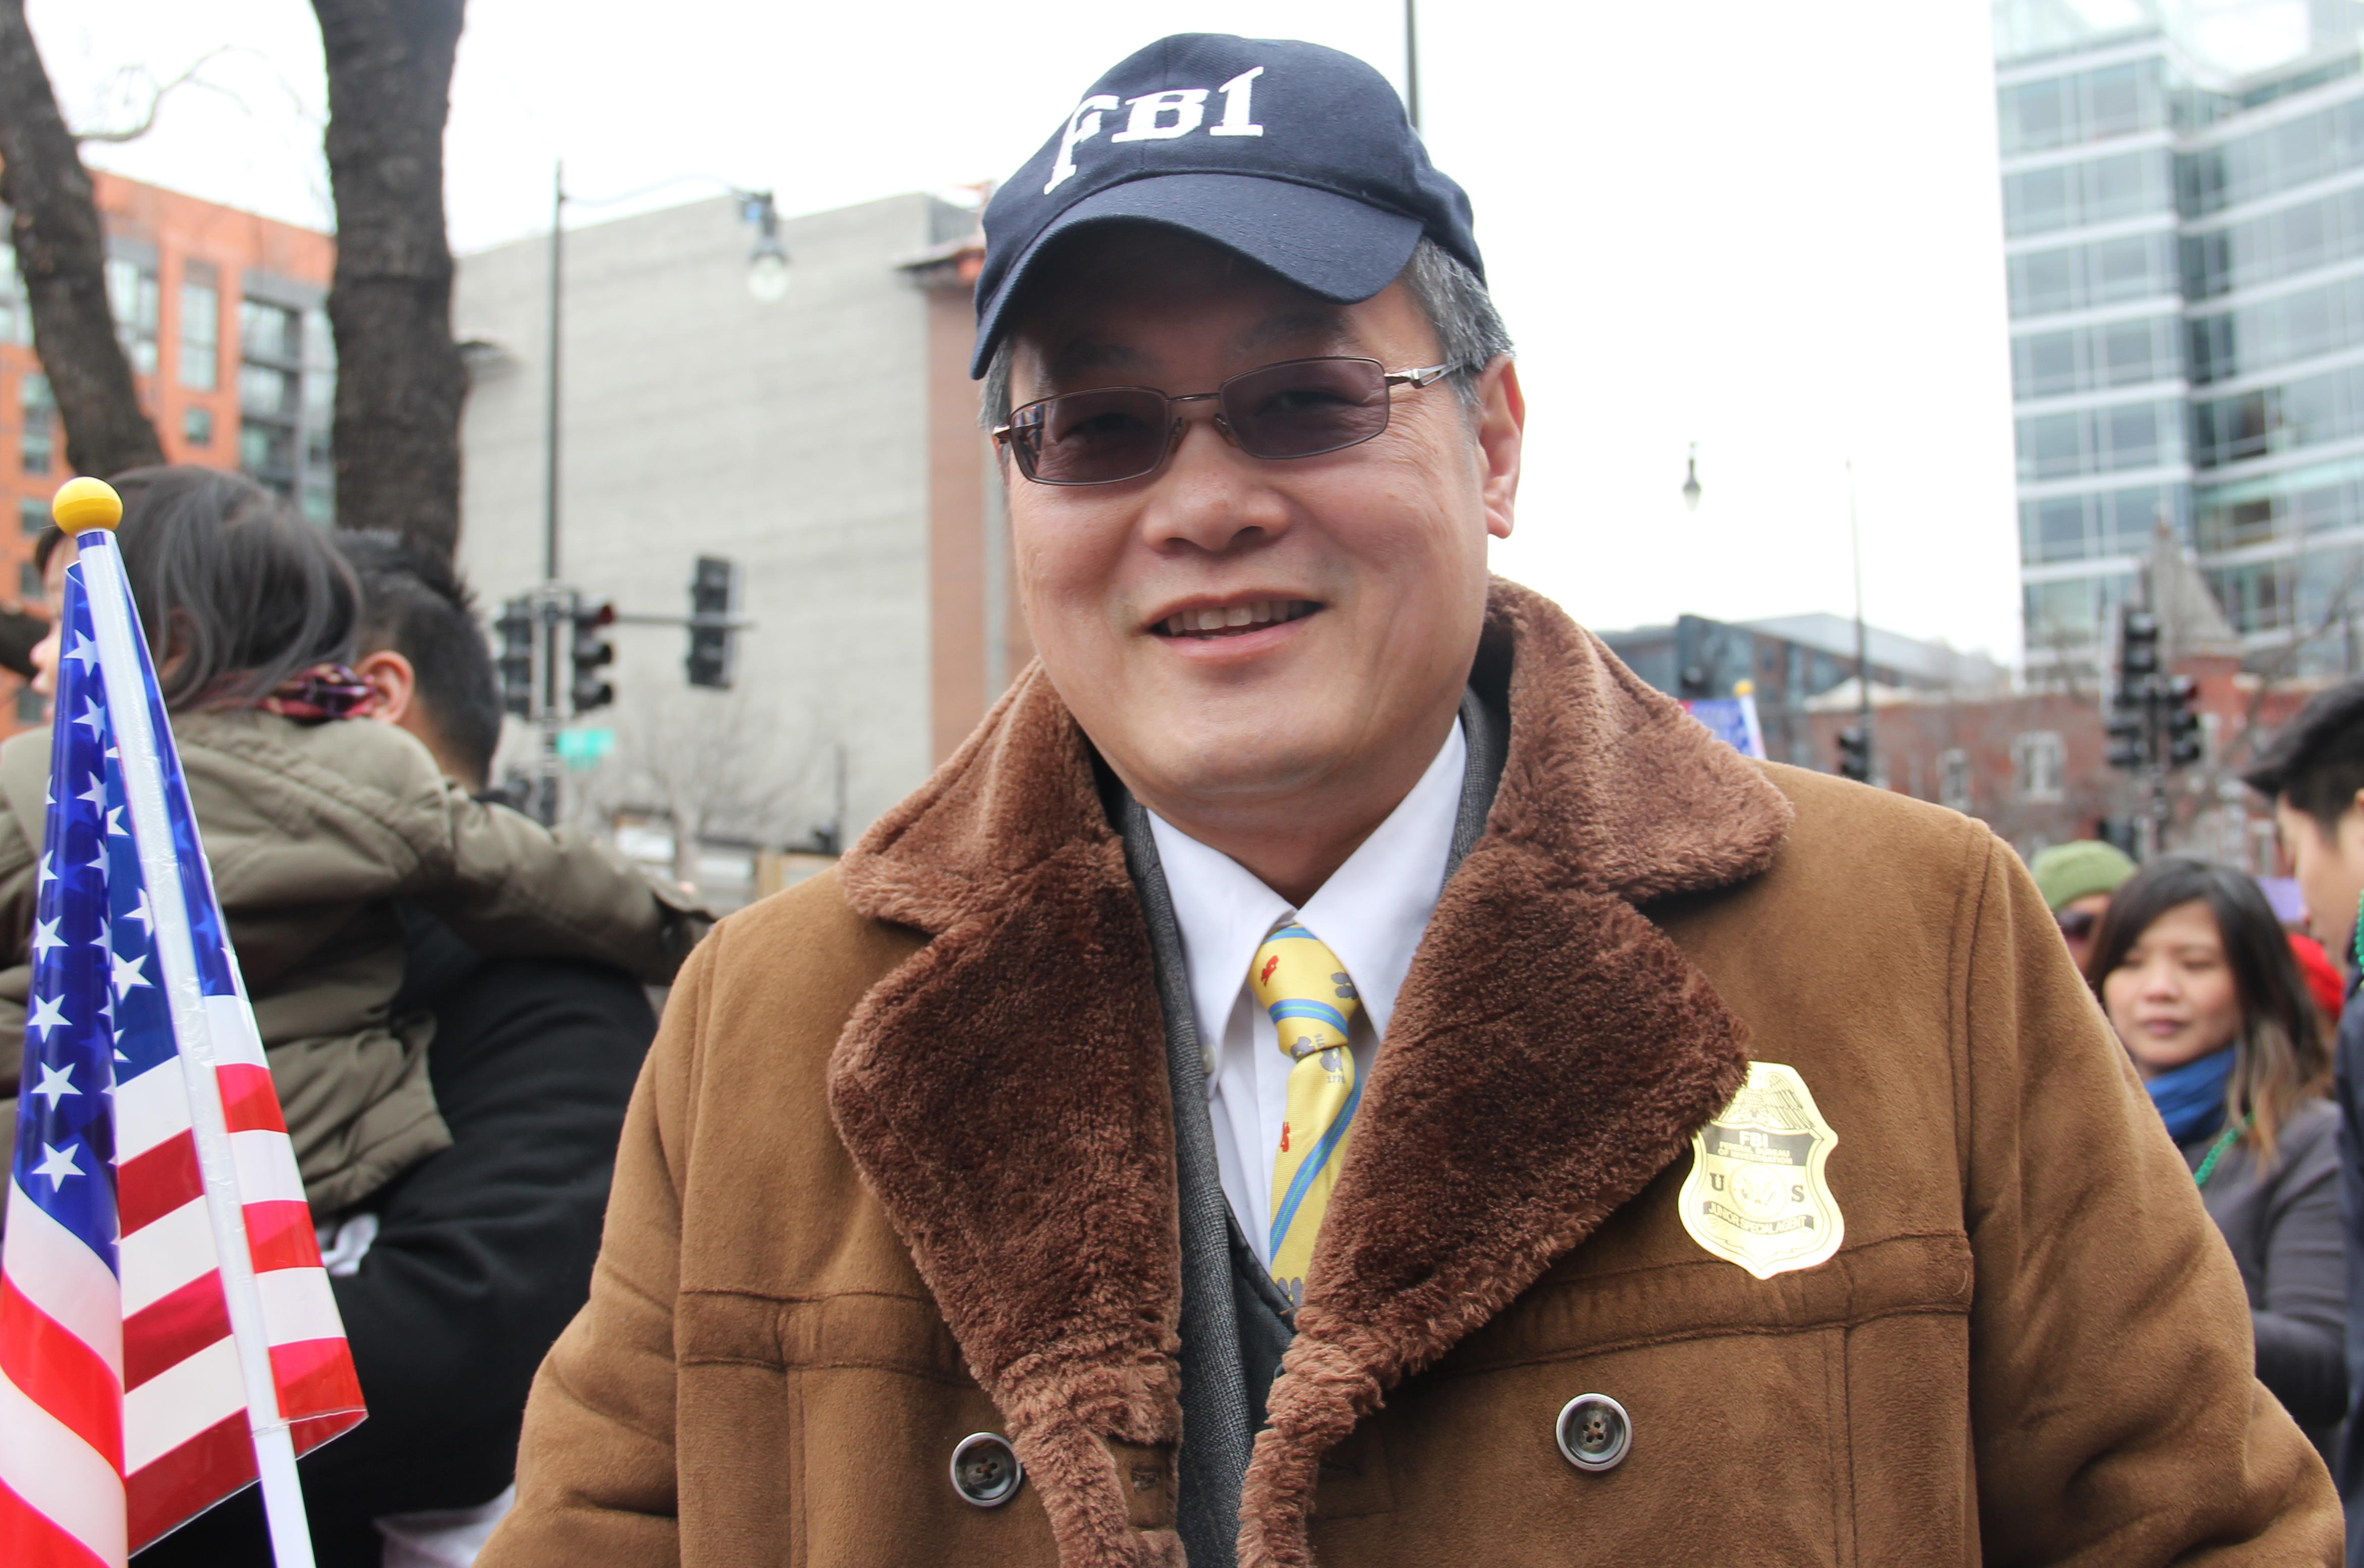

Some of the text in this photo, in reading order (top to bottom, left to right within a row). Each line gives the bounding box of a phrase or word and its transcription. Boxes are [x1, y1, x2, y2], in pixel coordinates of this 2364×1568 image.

[1044, 66, 1264, 195] FBI
[1719, 1141, 1790, 1157] FEDERAL BUREAU
[1739, 1130, 1768, 1148] FBI
[1717, 1148, 1793, 1164] OF INVESTIGATION
[1709, 1172, 1805, 1203] U S
[1708, 1202, 1807, 1234] JUNIOR SPECIAL AGENT
